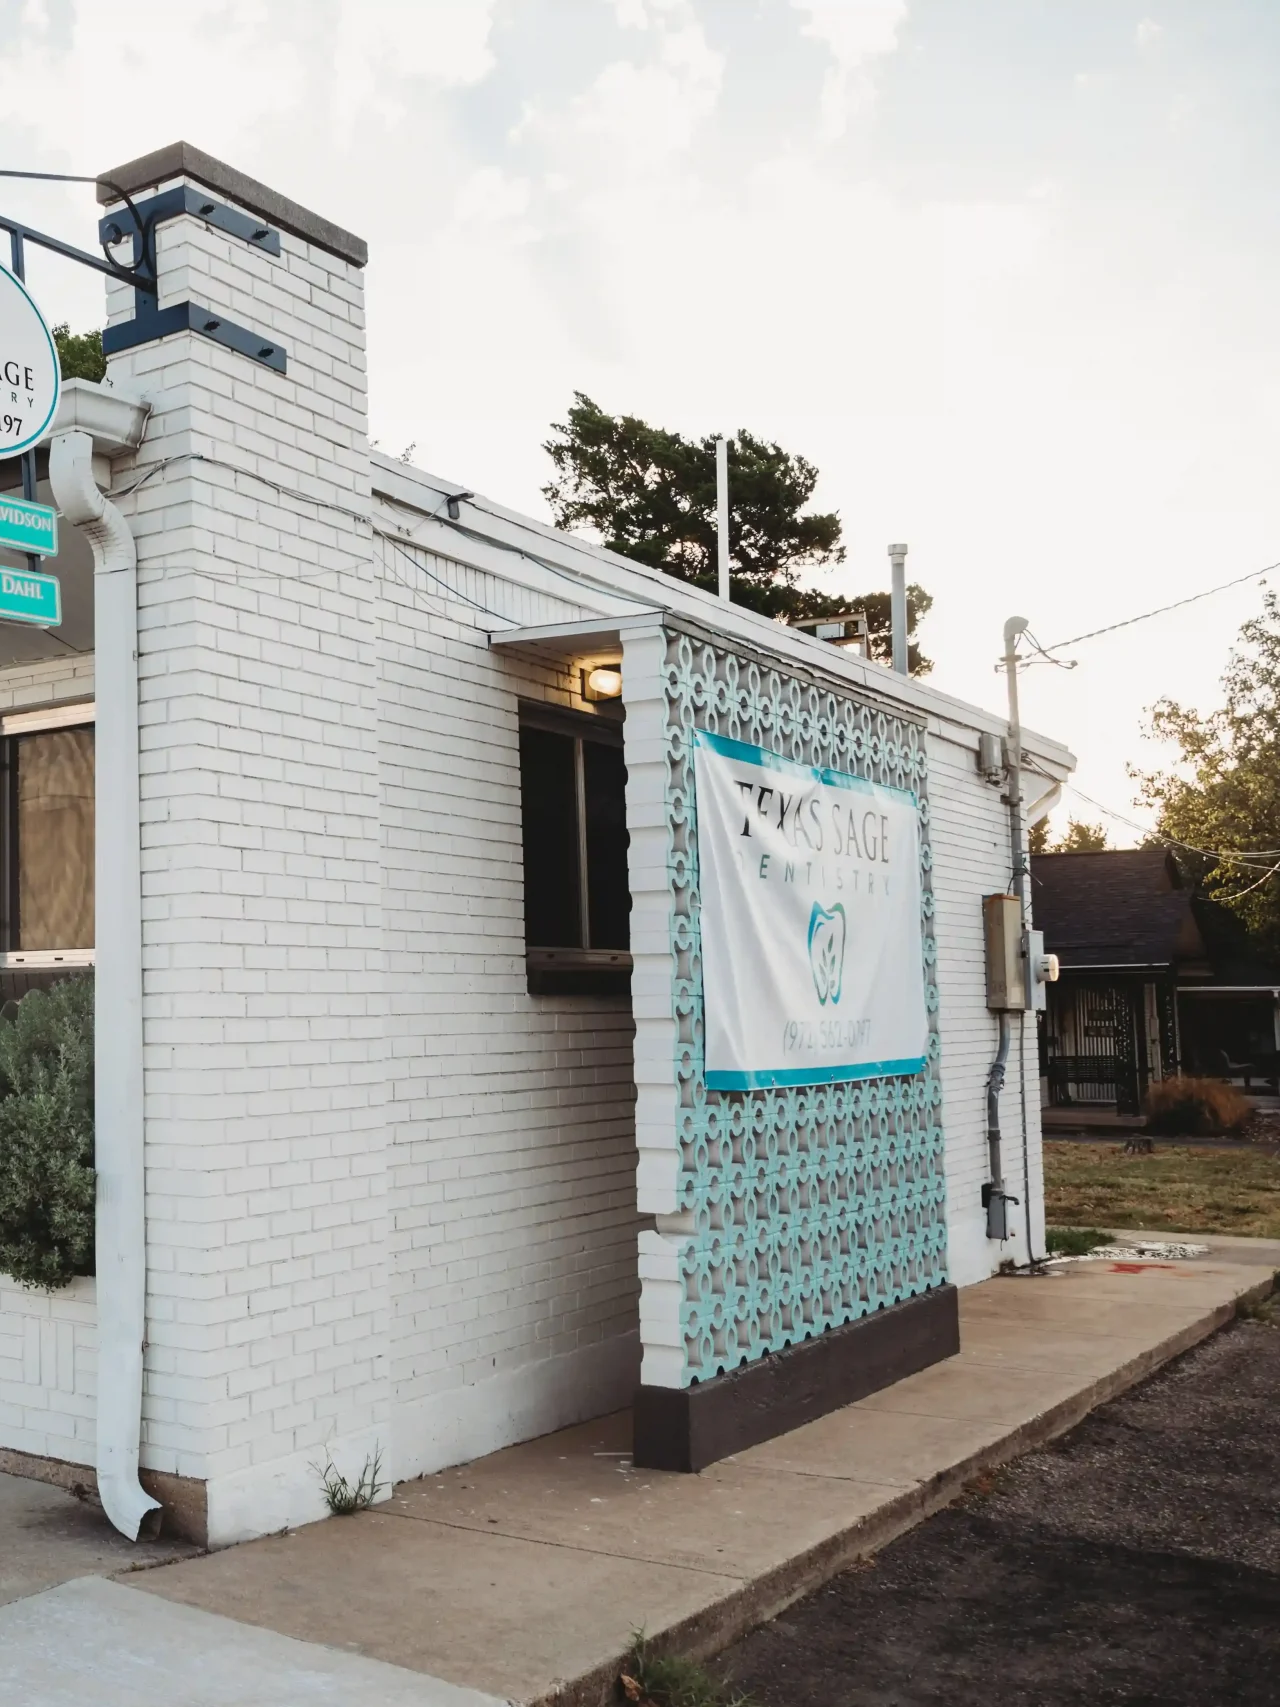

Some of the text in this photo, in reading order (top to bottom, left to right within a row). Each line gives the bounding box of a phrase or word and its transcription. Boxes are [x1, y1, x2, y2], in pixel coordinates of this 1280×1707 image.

[2, 574, 44, 600] DAHL
[733, 780, 890, 864] TEXAS SAGE
